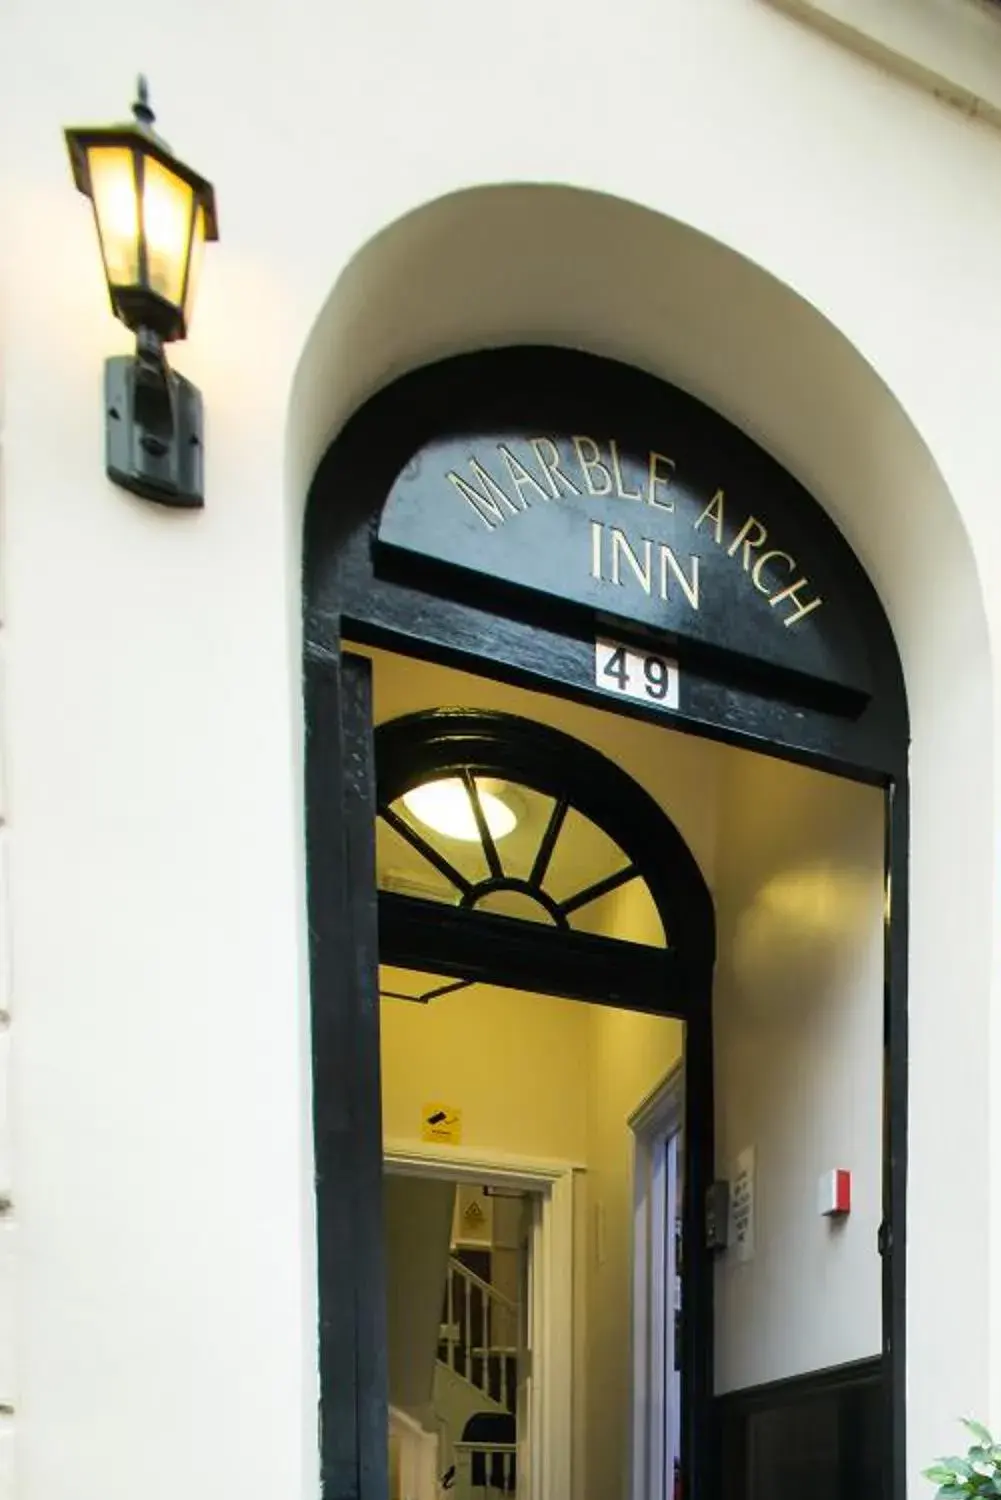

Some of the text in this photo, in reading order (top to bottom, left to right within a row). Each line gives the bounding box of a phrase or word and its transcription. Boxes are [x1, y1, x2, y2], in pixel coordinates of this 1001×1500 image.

[446, 435, 823, 629] MARBLE ARCH
[588, 519, 700, 610] INN
[604, 643, 668, 698] 49
